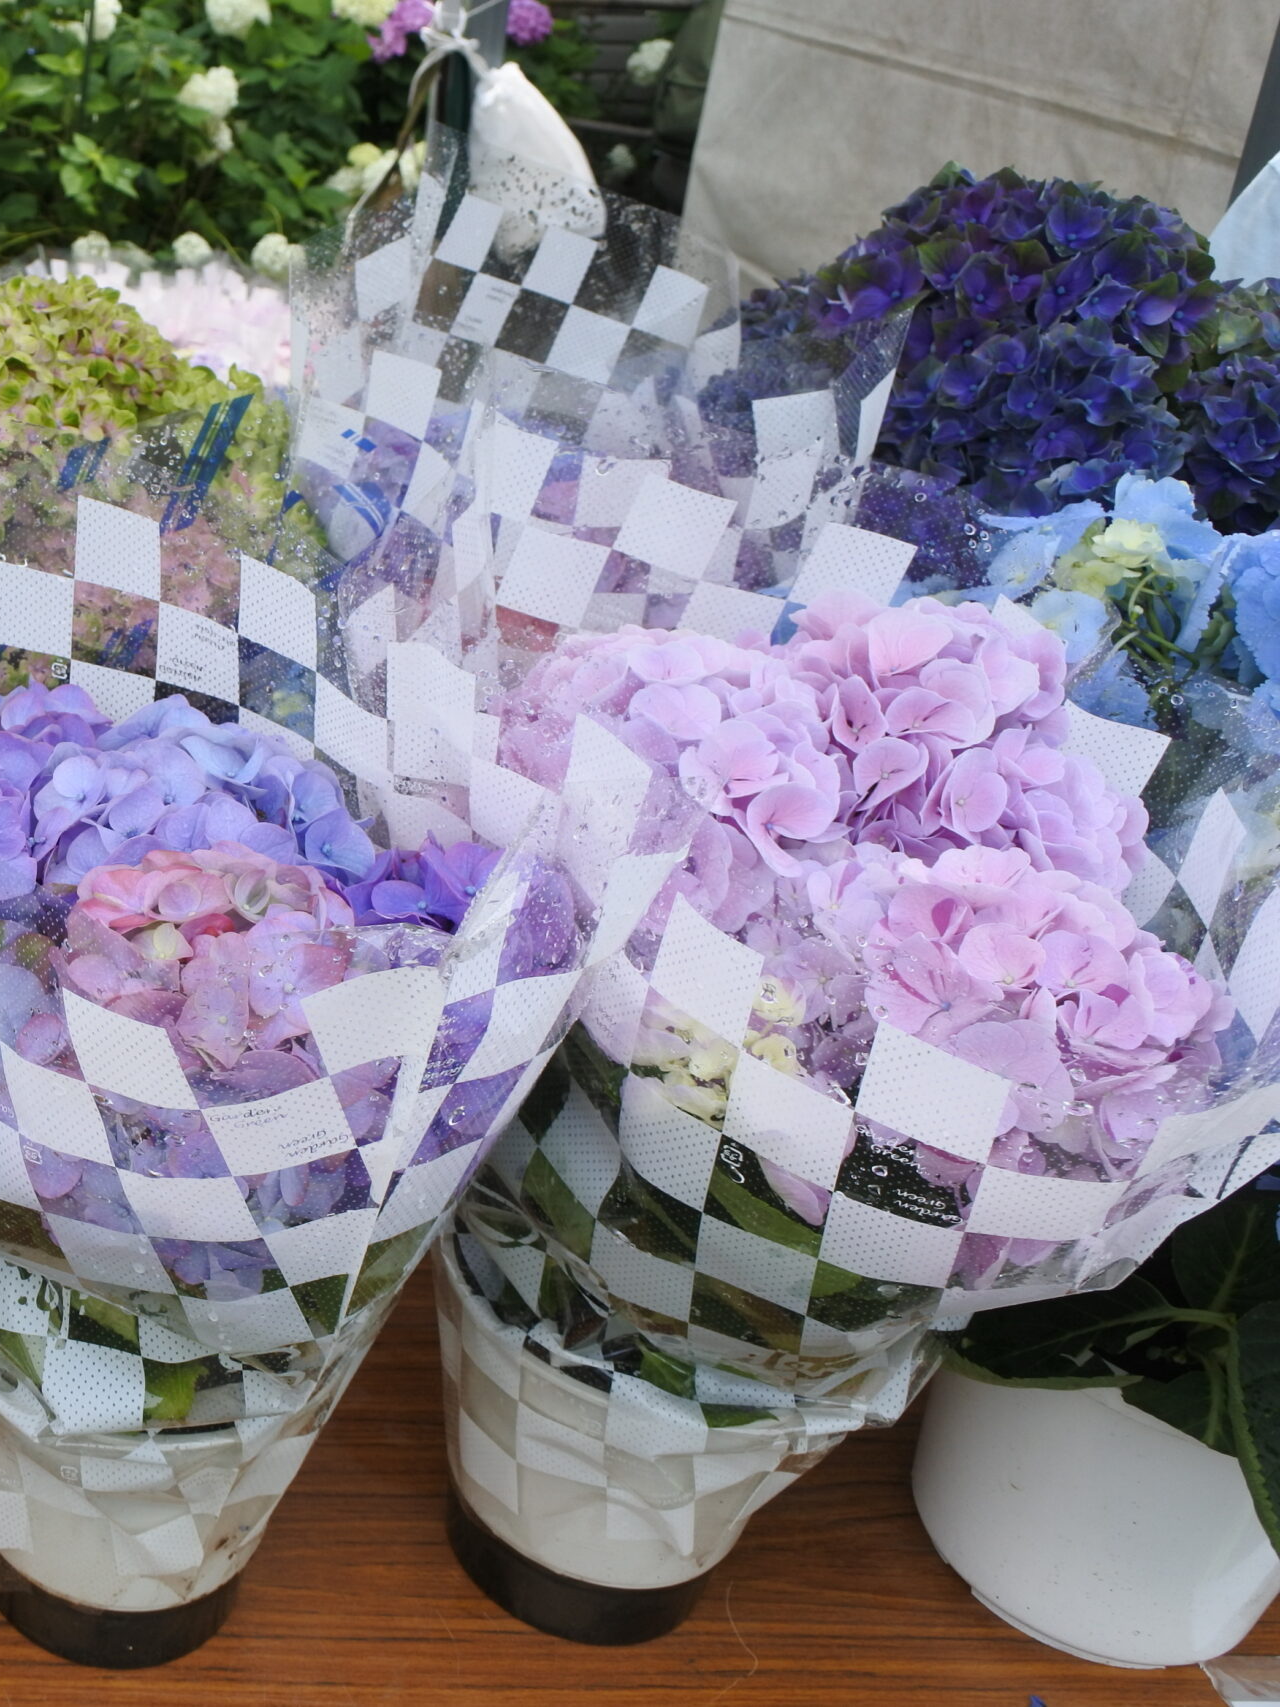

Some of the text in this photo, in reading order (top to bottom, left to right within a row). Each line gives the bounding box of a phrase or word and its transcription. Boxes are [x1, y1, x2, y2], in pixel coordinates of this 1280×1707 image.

[209, 1105, 283, 1123] Garden
[233, 1113, 289, 1129] Green
[278, 1129, 327, 1149] Green
[286, 1133, 350, 1158] Garden
[854, 1124, 925, 1159] Garden
[871, 1143, 924, 1173] Green
[896, 1188, 946, 1210] Green
[894, 1200, 963, 1224] Garden
